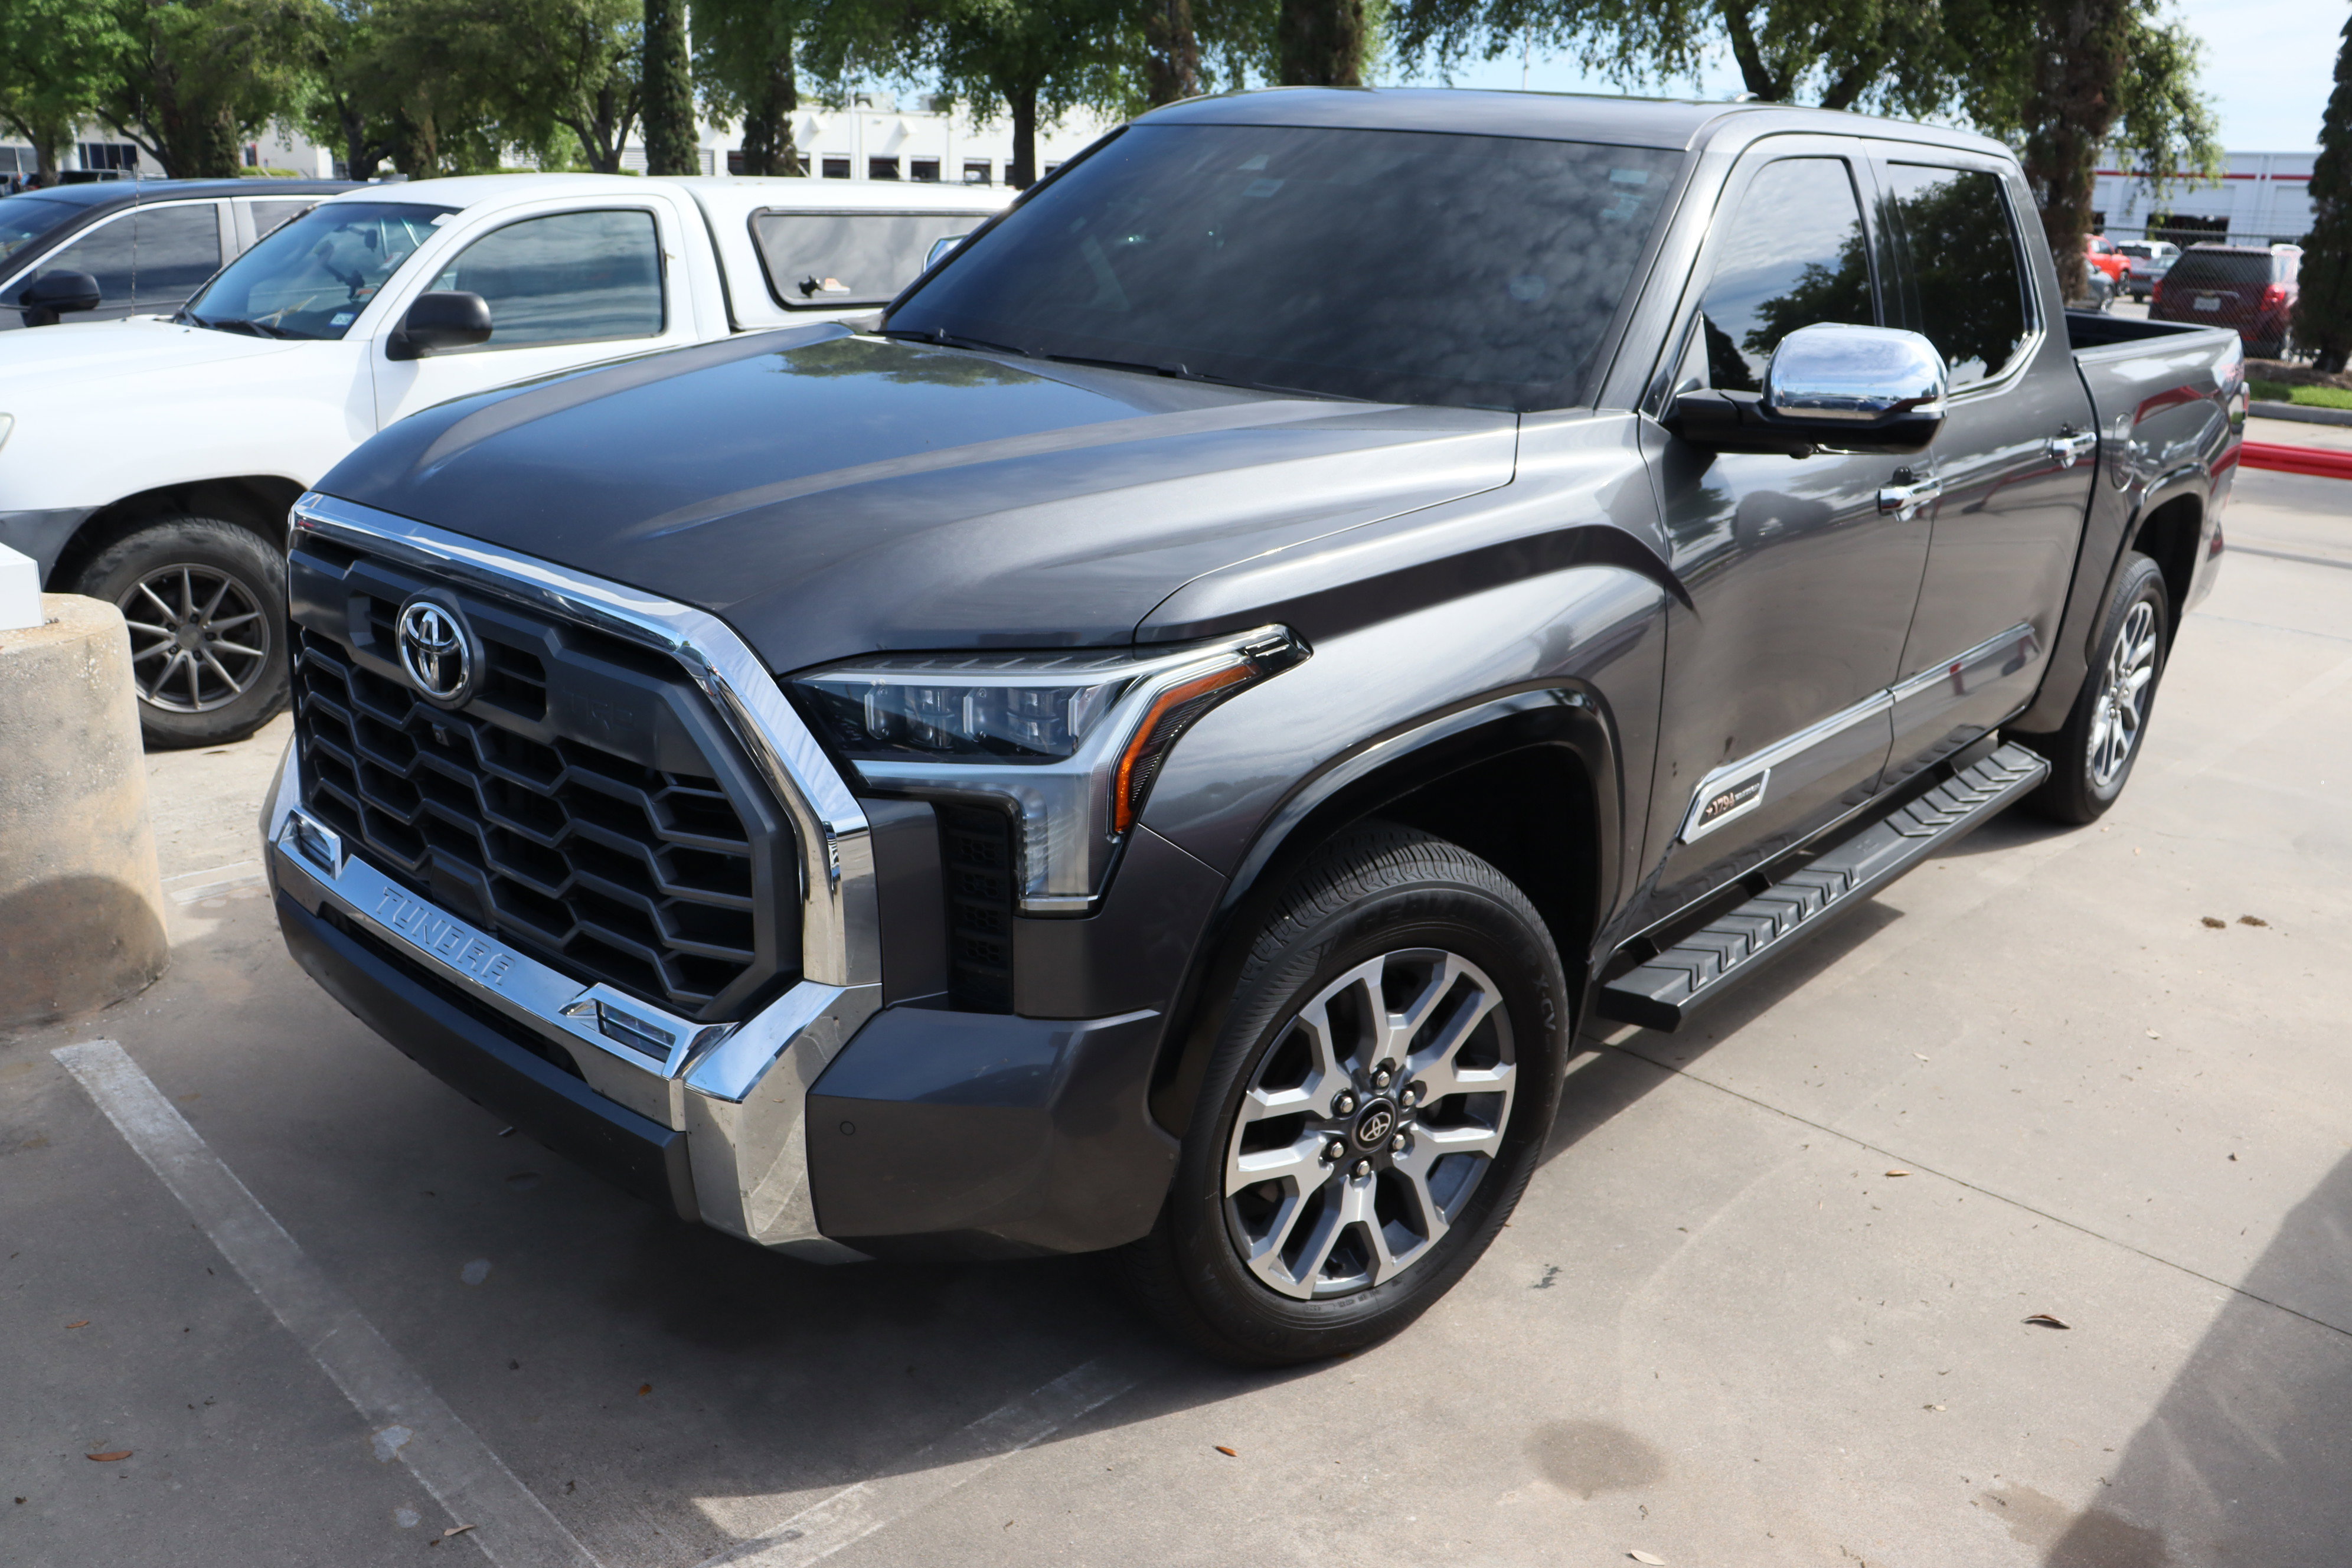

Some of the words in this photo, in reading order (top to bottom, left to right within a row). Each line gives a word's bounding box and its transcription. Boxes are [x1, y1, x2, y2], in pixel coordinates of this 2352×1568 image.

[1713, 792, 1734, 815] 1794
[376, 887, 515, 986] TUNDRA
[1354, 897, 1538, 968] GEOLAR
[1534, 974, 1557, 1031] X-CV
